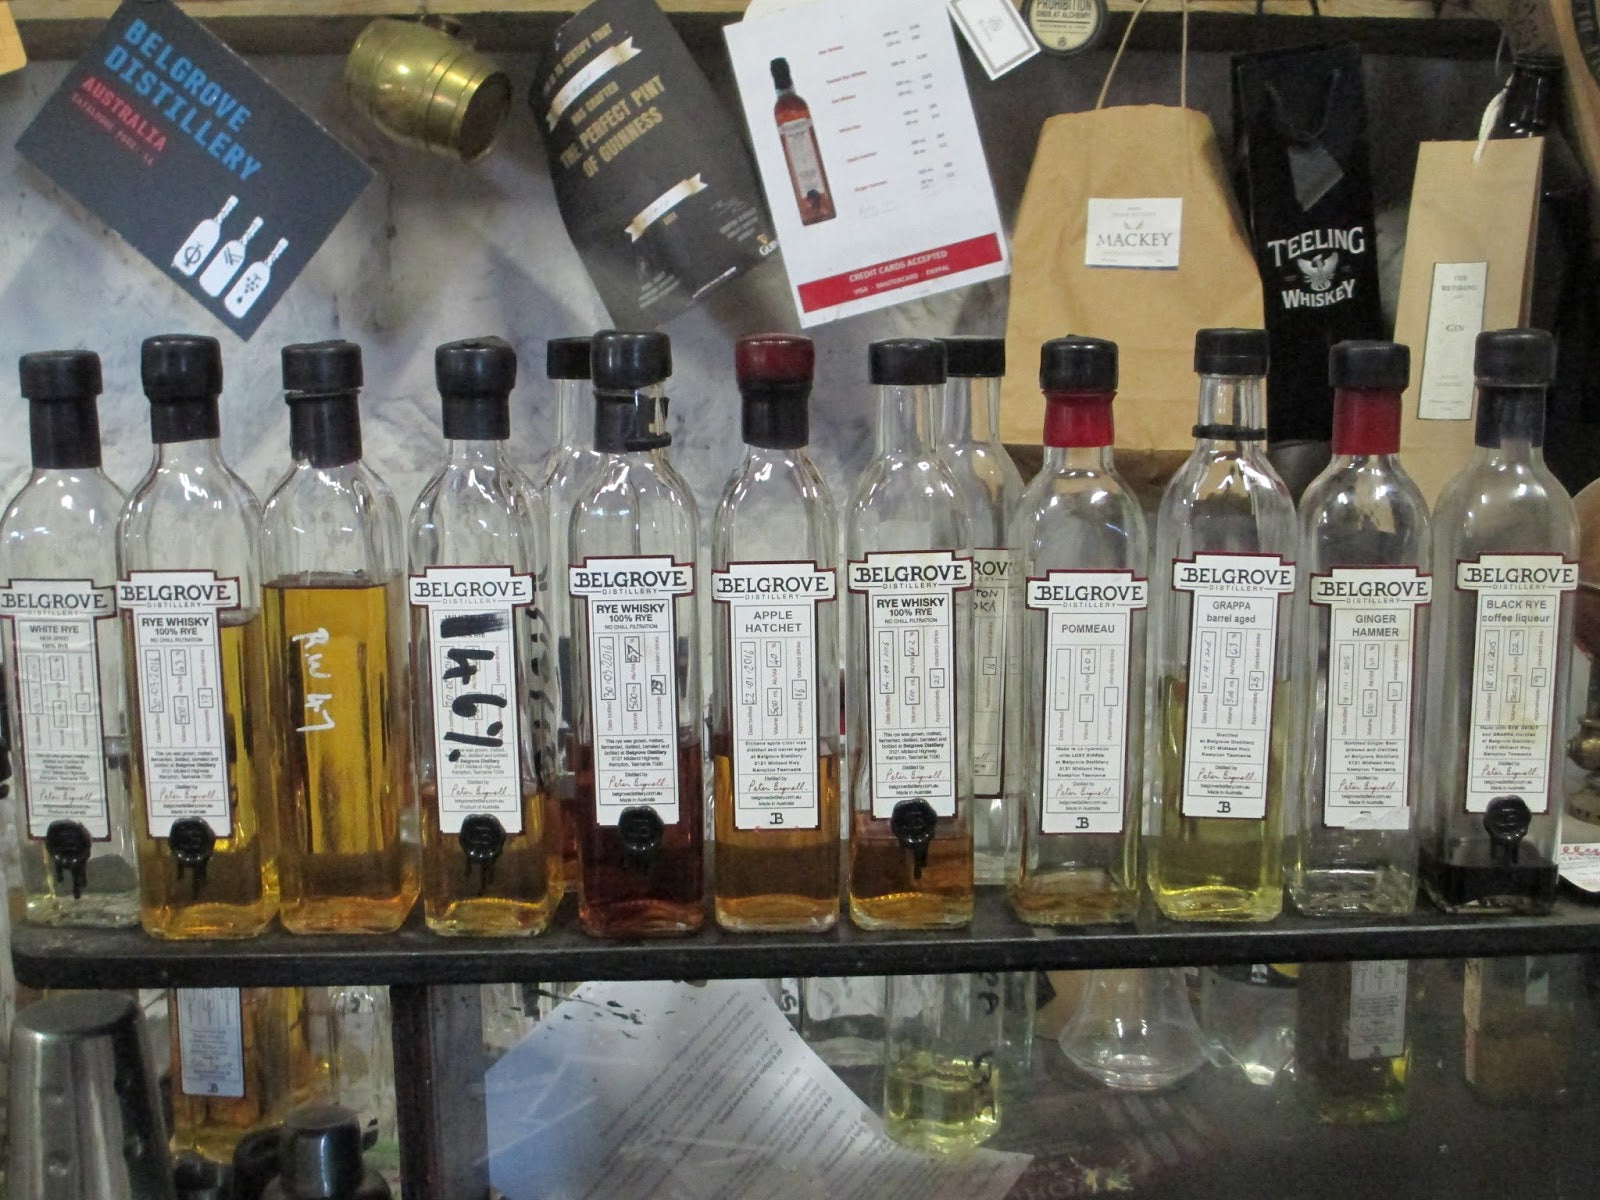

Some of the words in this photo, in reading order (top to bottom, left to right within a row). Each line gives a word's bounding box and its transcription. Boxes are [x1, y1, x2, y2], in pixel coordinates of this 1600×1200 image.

[124, 18, 252, 133] BELGROVE
[82, 76, 167, 152] AUSTRALIA
[104, 44, 262, 181] DISTILLERY
[580, 99, 630, 148] PERFECT
[630, 75, 665, 107] PINT
[582, 158, 599, 178] OF
[599, 106, 664, 162] GUINNESS
[1096, 232, 1173, 247] MACKEY
[1267, 227, 1365, 267] TEELING
[849, 268, 878, 283] CREDIT
[879, 261, 906, 276] CARDS
[905, 250, 948, 270] ACCEPTED
[1282, 279, 1355, 309] WHISKEY
[574, 570, 686, 588] BELGROVE
[854, 564, 966, 583] BELGROVE
[1180, 567, 1291, 585] BELGROVE
[1464, 567, 1575, 583] BELGROVE
[414, 580, 526, 598] BELGROVE
[717, 576, 829, 593] BELGROVE
[1317, 581, 1428, 597] BELGROVE
[121, 584, 231, 601] BELGROVE
[1034, 585, 1144, 601] BELGROVE
[1, 594, 107, 608] BELGROVE
[597, 605, 618, 613] RYE
[621, 604, 665, 612] WHISKY
[876, 599, 898, 608] RYE
[901, 598, 945, 607] WHISKY
[1212, 601, 1251, 611] GRAPPA
[1487, 600, 1523, 609] BLACK
[1526, 601, 1546, 609] RYE
[753, 610, 793, 620] APPLE
[889, 609, 912, 617] 100%
[915, 608, 932, 616] RYE
[1206, 614, 1232, 623] barrel
[1234, 615, 1256, 625] aged
[1355, 614, 1397, 624] GINGER
[1481, 613, 1513, 623] coffee
[1515, 613, 1550, 625] liqueur
[142, 618, 163, 627] RYE
[166, 617, 210, 626] WHISKY
[745, 623, 801, 633] HATCHET
[1061, 625, 1115, 633] POMMEAU
[155, 628, 178, 636] 100%
[180, 627, 198, 635] RYE
[1352, 627, 1399, 637] HAMMER
[609, 776, 631, 788] Peter
[748, 780, 770, 792] Peter
